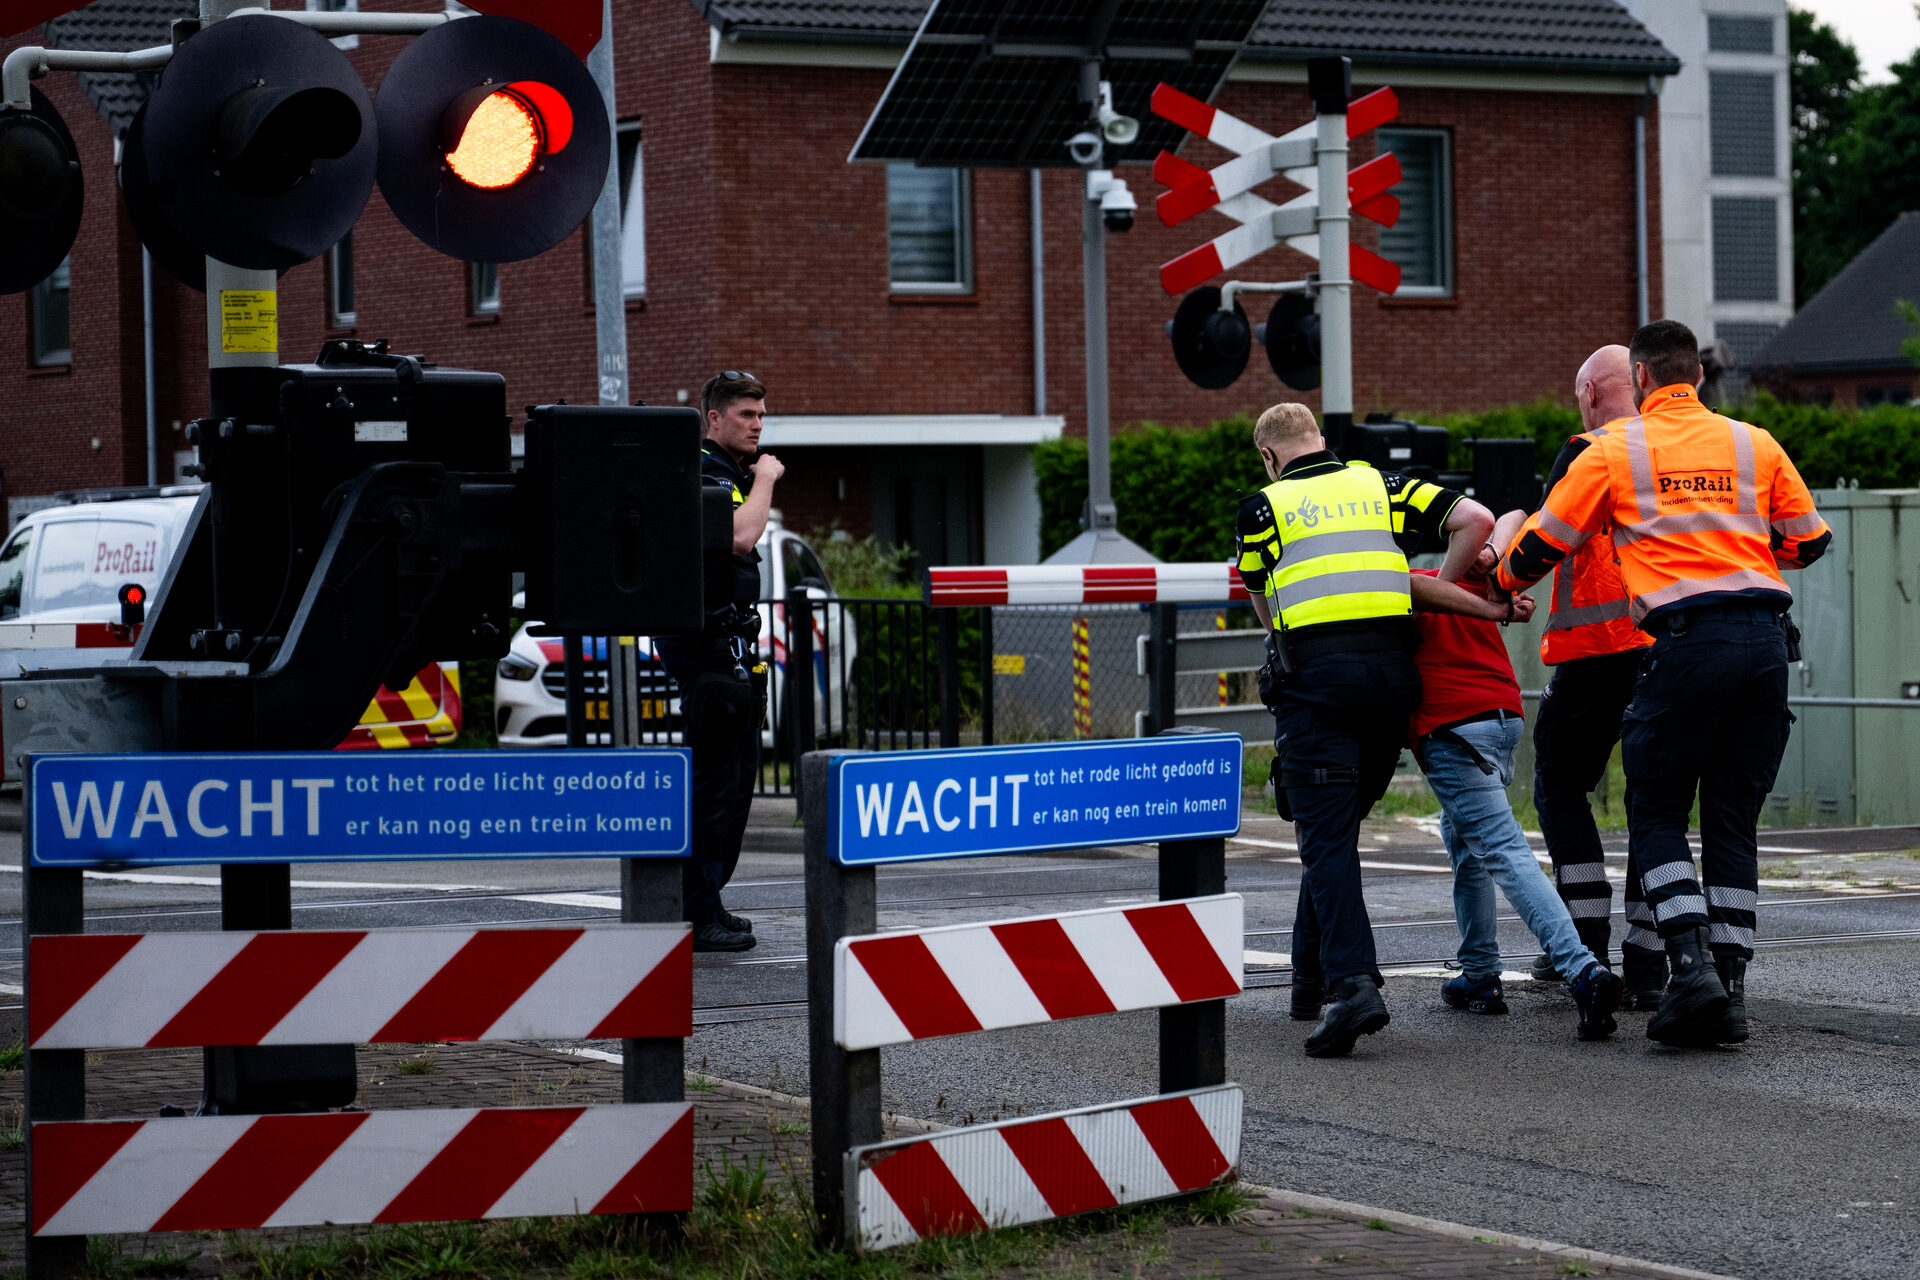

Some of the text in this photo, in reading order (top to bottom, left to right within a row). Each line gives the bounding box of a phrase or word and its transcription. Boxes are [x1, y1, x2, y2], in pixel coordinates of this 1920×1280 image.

[1658, 476, 1733, 493] ProRail
[1284, 495, 1384, 528] POLITIE
[94, 540, 156, 575] ProRail
[345, 770, 672, 796] tot het rode licht gedoofd is
[1034, 758, 1231, 786] tot het rode licht gedoofd is
[51, 778, 335, 839] WACHT
[855, 774, 1029, 838] WACHT
[1033, 797, 1227, 825] er kan nog een trein komen
[345, 813, 672, 840] er kan nog een trein komen
